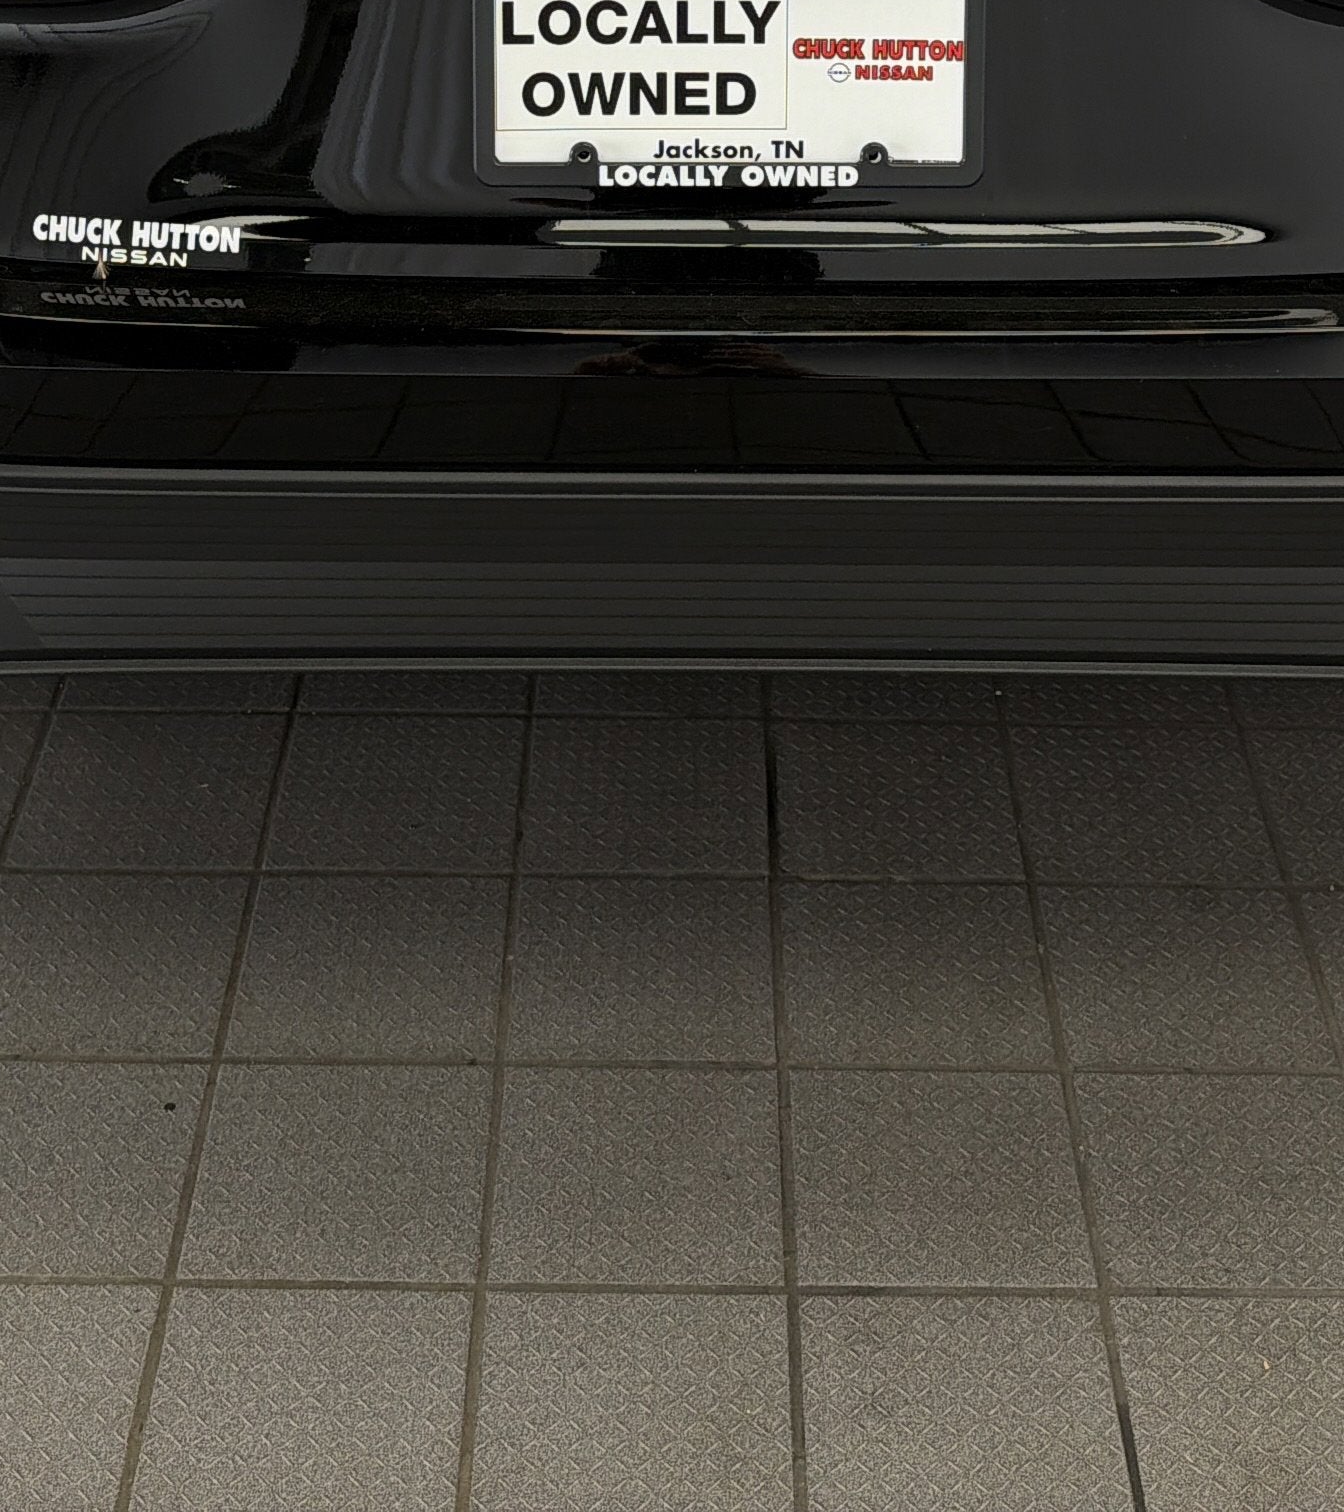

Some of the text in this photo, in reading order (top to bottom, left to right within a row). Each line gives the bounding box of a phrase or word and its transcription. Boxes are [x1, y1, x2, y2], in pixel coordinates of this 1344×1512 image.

[502, 0, 782, 45] LOCALLY
[792, 38, 964, 61] CHUCK HUTTON
[855, 65, 933, 81] NISSAN
[521, 71, 757, 117] OWNED
[653, 138, 804, 161] Jackson, TN
[598, 165, 859, 187] LOCALLY OWNED
[32, 214, 241, 253] CHUCK HUTTON
[81, 246, 188, 267] NISSAN
